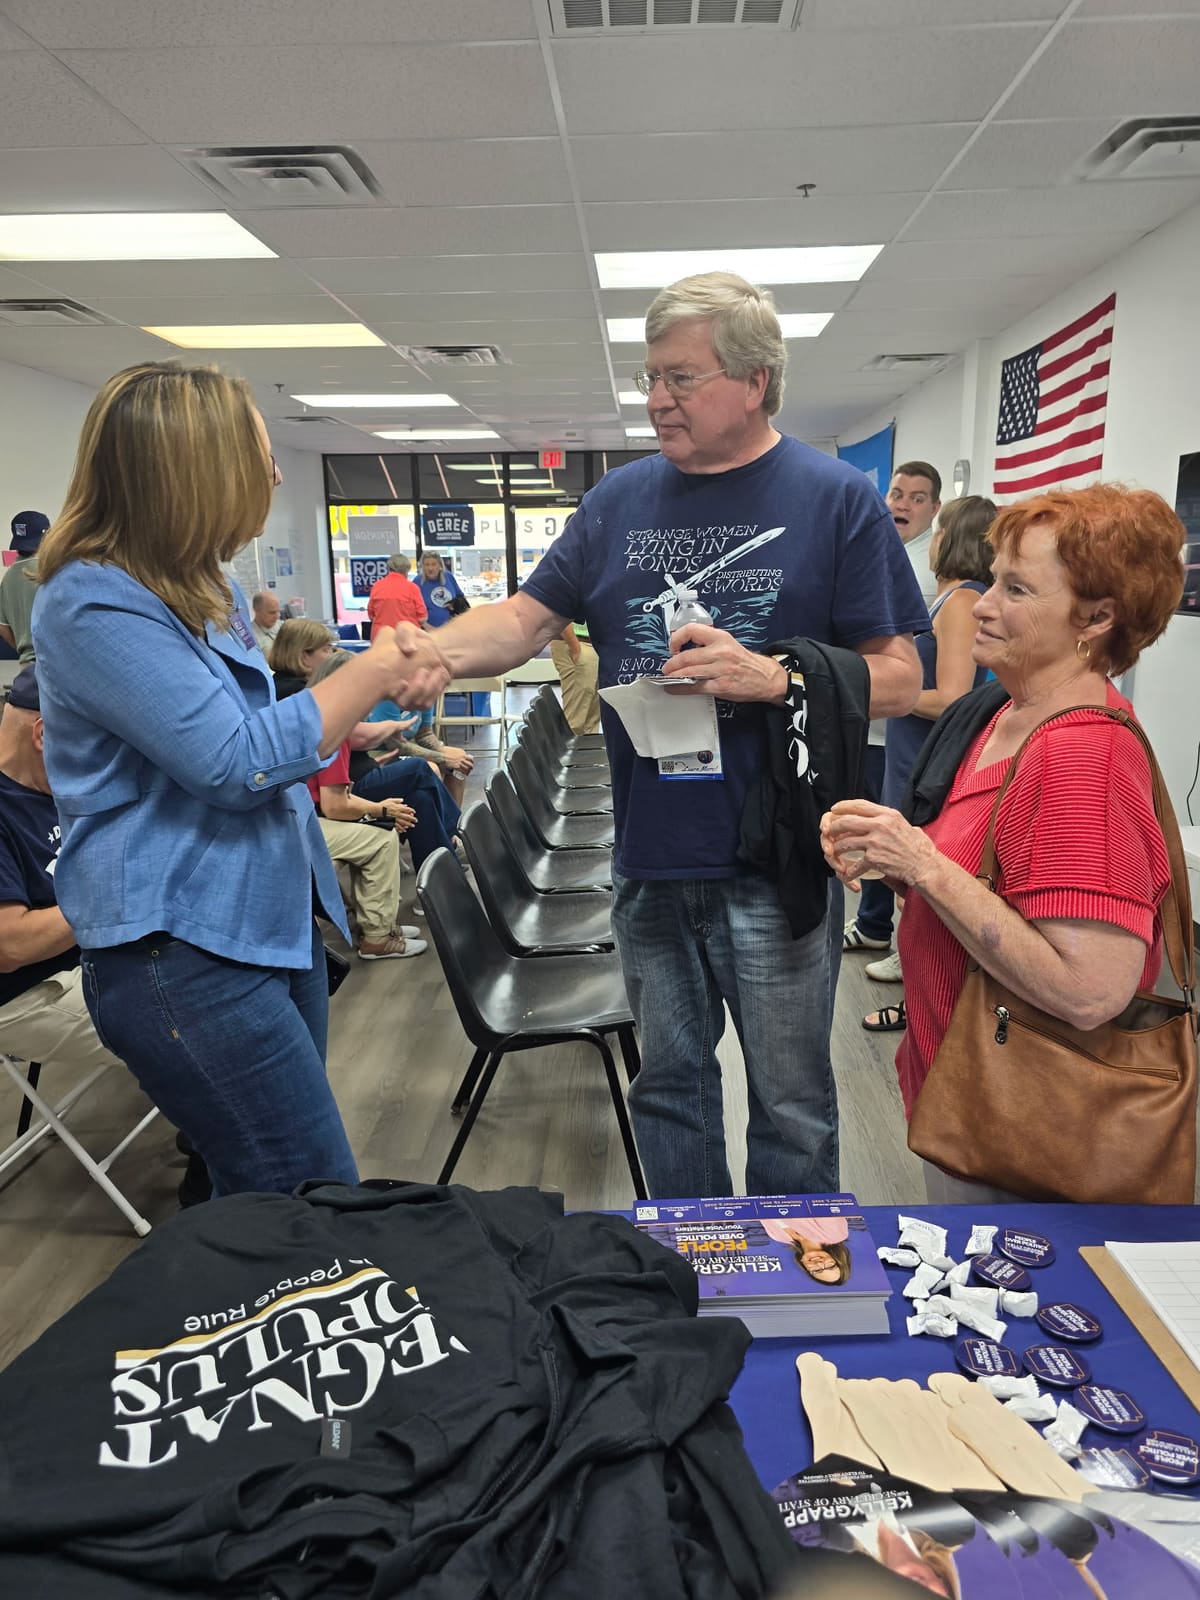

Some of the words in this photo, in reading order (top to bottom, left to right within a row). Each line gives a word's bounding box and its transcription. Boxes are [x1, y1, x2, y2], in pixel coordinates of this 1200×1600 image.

[543, 450, 560, 466] EXIT
[426, 517, 469, 533] DEREE
[626, 528, 693, 540] STRANGE
[696, 525, 758, 537] WOMEN
[623, 539, 695, 555] LYING
[698, 536, 729, 554] IN
[352, 561, 387, 576] ROB
[625, 555, 703, 573] PONDS
[716, 569, 783, 580] DISTRIBUTING
[702, 577, 784, 594] SWORDS
[618, 658, 631, 672] IS
[632, 657, 654, 671] NO
[675, 1233, 716, 1242] POLITICS
[1020, 1240, 1048, 1250] POLITICS
[676, 1238, 747, 1253] PEOPLE
[254, 1258, 344, 1309] People
[183, 1303, 248, 1333] Rule
[1052, 1304, 1069, 1315] OVER
[1065, 1314, 1090, 1330] POLITICS
[1065, 1309, 1086, 1323] PEOPLE
[972, 1348, 984, 1363] PEOPLE
[977, 1340, 989, 1357] POLITICS
[1045, 1348, 1061, 1361] OVER
[1055, 1360, 1073, 1378] POLITICS
[1057, 1354, 1074, 1369] PEOPLE
[98, 1312, 471, 1468] EGNAT
[1089, 1386, 1111, 1406] POLITICS
[1090, 1395, 1110, 1414] PEOPLE
[1107, 1407, 1124, 1422] OVER
[1139, 1444, 1174, 1457] POLITICS
[1174, 1452, 1198, 1463] OVER
[1154, 1454, 1184, 1466] PEOPLE
[813, 1497, 828, 1506] OF
[831, 1490, 896, 1505] SECRETARY
[783, 1495, 912, 1528] KELLYGRAPP
